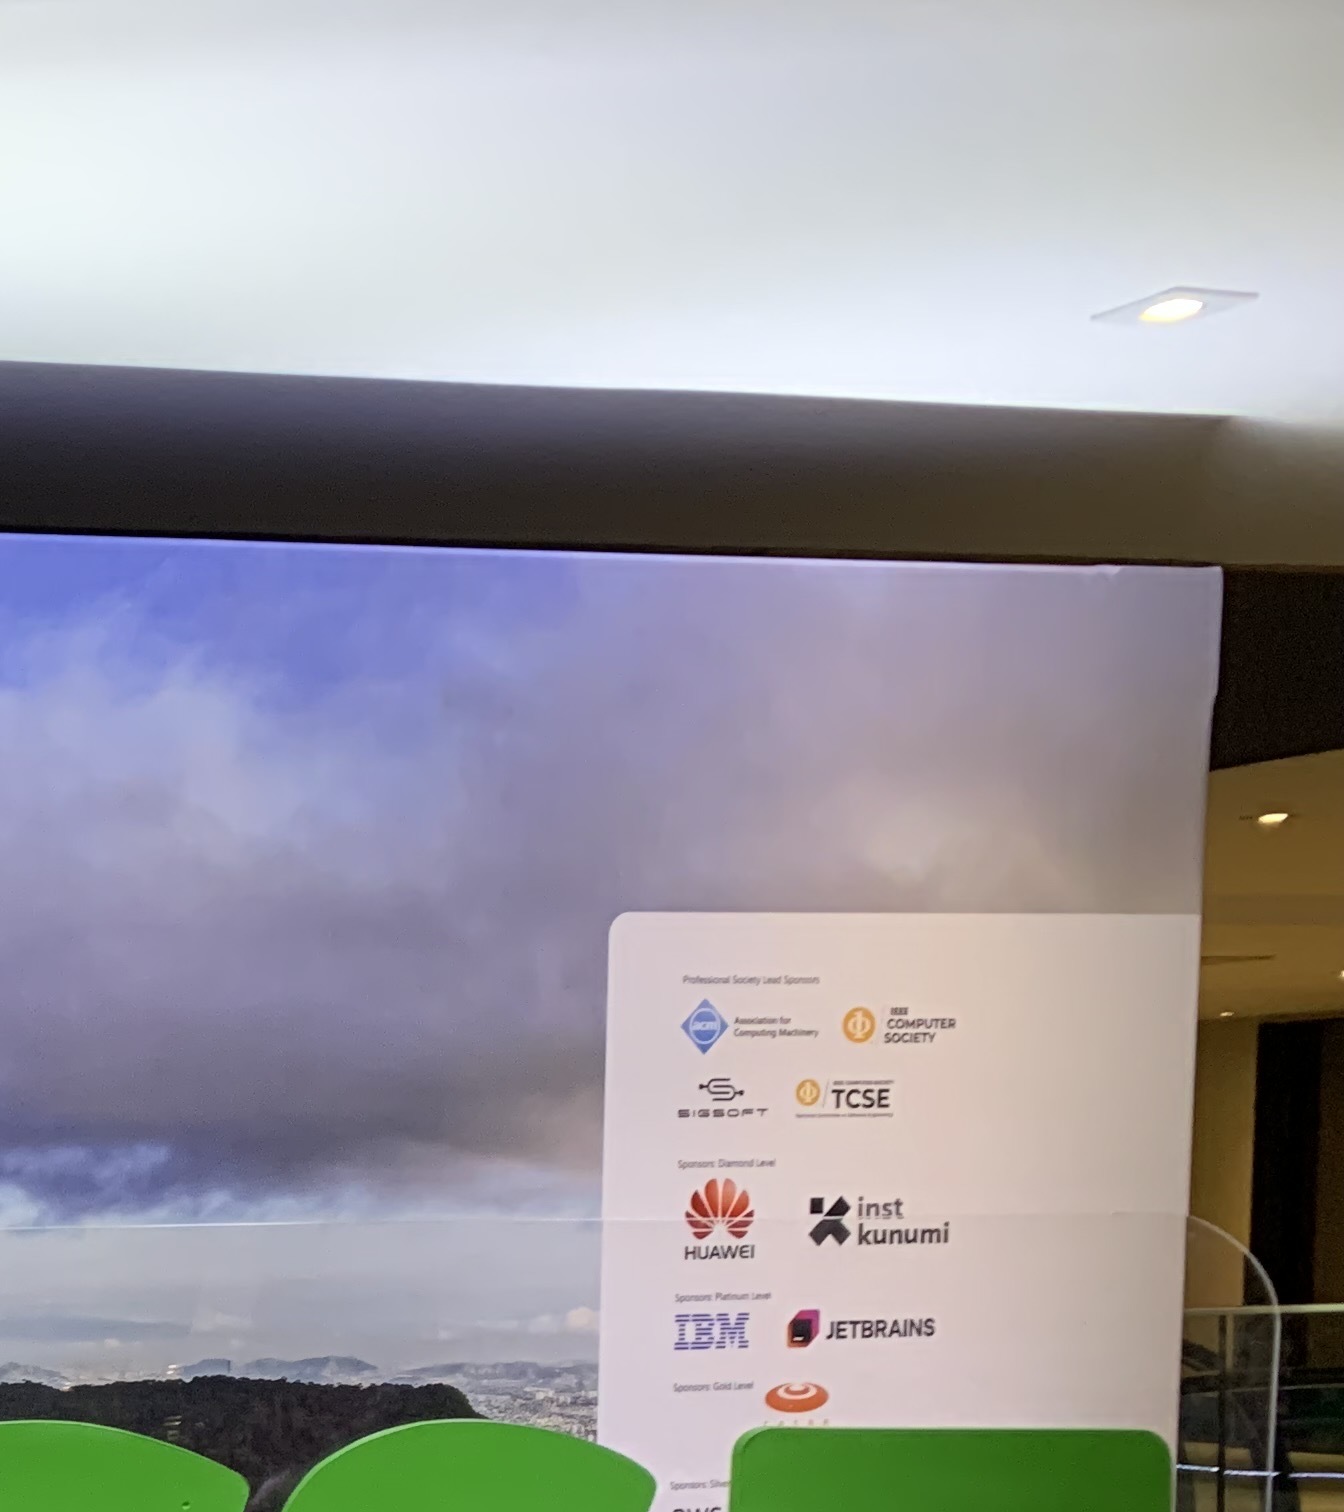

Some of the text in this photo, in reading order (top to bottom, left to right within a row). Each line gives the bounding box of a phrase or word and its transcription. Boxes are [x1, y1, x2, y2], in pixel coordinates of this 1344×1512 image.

[886, 1018, 956, 1030] COMPUTER
[884, 1032, 937, 1044] SOCIETY
[831, 1088, 891, 1109] TCSE
[677, 1107, 769, 1118] SIGSOFT
[857, 1197, 904, 1219] inst
[857, 1222, 950, 1246] kunumi
[684, 1244, 755, 1260] HUAWEI
[674, 1312, 750, 1350] IBM
[825, 1318, 936, 1340] JETBRAINS
